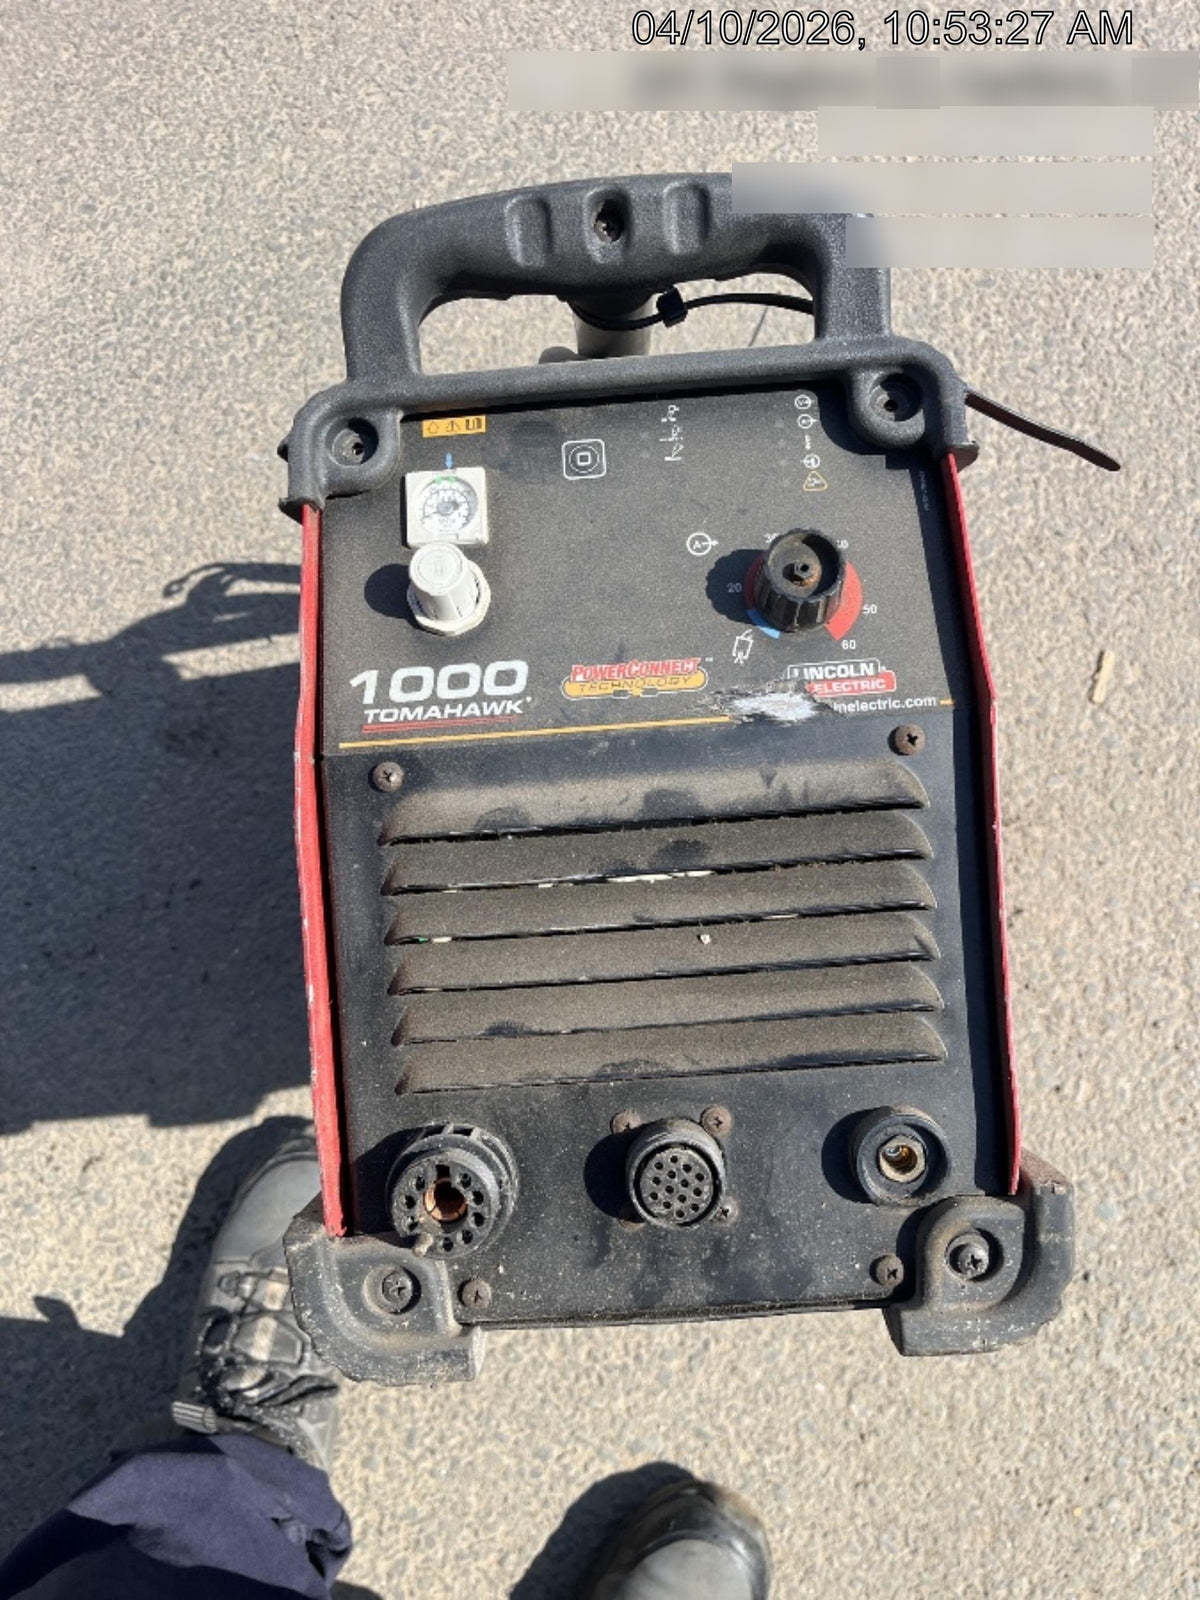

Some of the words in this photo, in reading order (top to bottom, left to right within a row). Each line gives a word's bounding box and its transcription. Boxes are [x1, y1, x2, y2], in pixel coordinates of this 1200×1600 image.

[726, 582, 742, 594] 20
[861, 603, 877, 615] 50
[841, 639, 856, 651] 60
[350, 659, 529, 705] 1000
[579, 676, 692, 693] TECHNOLOGY
[814, 677, 887, 695] ELECTRIC
[363, 699, 524, 725] TOMAHAWK
